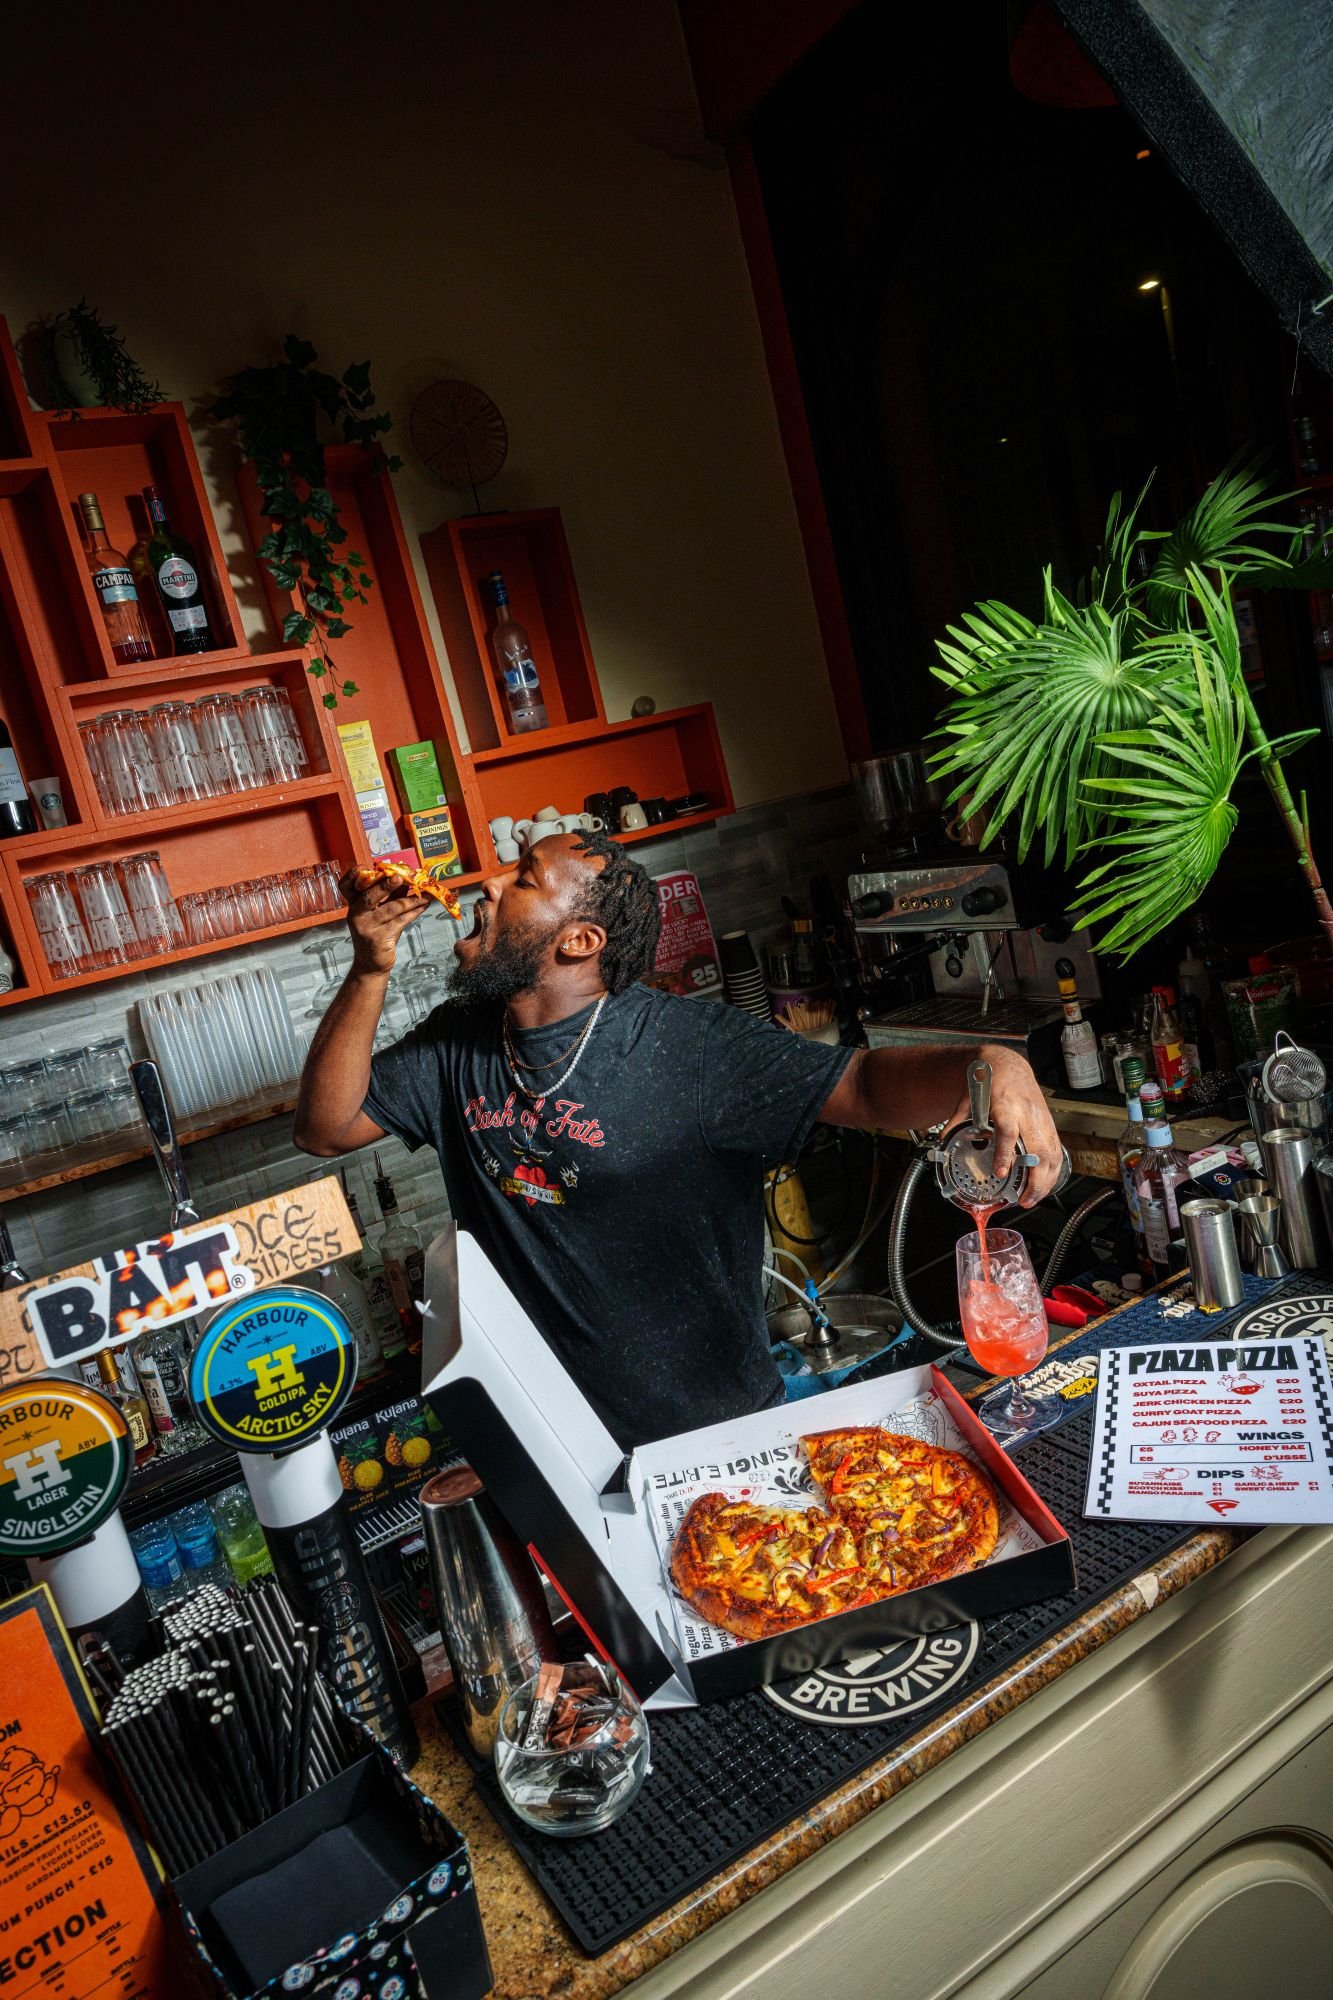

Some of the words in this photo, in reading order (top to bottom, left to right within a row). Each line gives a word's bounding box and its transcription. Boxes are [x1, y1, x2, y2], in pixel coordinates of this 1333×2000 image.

[95, 573, 135, 589] CAMPAR
[162, 573, 196, 586] MARTINI
[418, 824, 449, 836] TWININGS
[422, 835, 438, 844] English
[423, 838, 449, 849] Breakfast
[658, 880, 698, 902] DER
[672, 936, 687, 945] THAT
[687, 932, 700, 941] YOU
[674, 923, 690, 932] LOOK
[691, 963, 719, 987] 25
[520, 1097, 546, 1135] of
[545, 1099, 606, 1148] Fate
[220, 1308, 309, 1355] HARBOUR
[310, 1343, 327, 1357] ABV
[1129, 1348, 1215, 1375] PZAZA
[1216, 1345, 1299, 1371] PIZZA
[86, 1371, 101, 1385] JIM
[219, 1377, 244, 1391] 4.3%
[1132, 1380, 1172, 1388] OXTAIL
[258, 1395, 288, 1413] COLD
[288, 1386, 307, 1401] IPA
[1163, 1388, 1198, 1396] PIZZA
[1163, 1398, 1215, 1406] CHICKEN
[0, 1402, 75, 1433] RBOUR
[236, 1411, 304, 1435] ARCTIC
[302, 1382, 332, 1418] SKY
[375, 1398, 418, 1425] Kulana
[1132, 1409, 1172, 1417] CURRY
[1132, 1420, 1173, 1428] CAJUN
[1173, 1418, 1230, 1426] SEAFOOD
[78, 1438, 97, 1452] ABV
[1236, 1431, 1305, 1441] WINGS
[1197, 1470, 1245, 1479] DIPS
[27, 1486, 69, 1511] LAGER
[1, 1483, 104, 1538] SINGLEFIN
[660, 1503, 671, 1519] than
[664, 1519, 676, 1542] better
[685, 1625, 700, 1658] regular
[701, 1626, 714, 1650] Pizza
[790, 1637, 963, 1713] BREWING
[44, 1800, 91, 1834] £13.50
[36, 1844, 61, 1863] FRUIT
[63, 1821, 99, 1847] PICANTE
[41, 1848, 73, 1871] LYCHEE
[75, 1829, 102, 1850] LOVER
[25, 1858, 73, 1891] CARDAMOM
[75, 1838, 106, 1860] MANGO
[24, 1879, 75, 1917] PUNCH
[88, 1855, 113, 1876] £15
